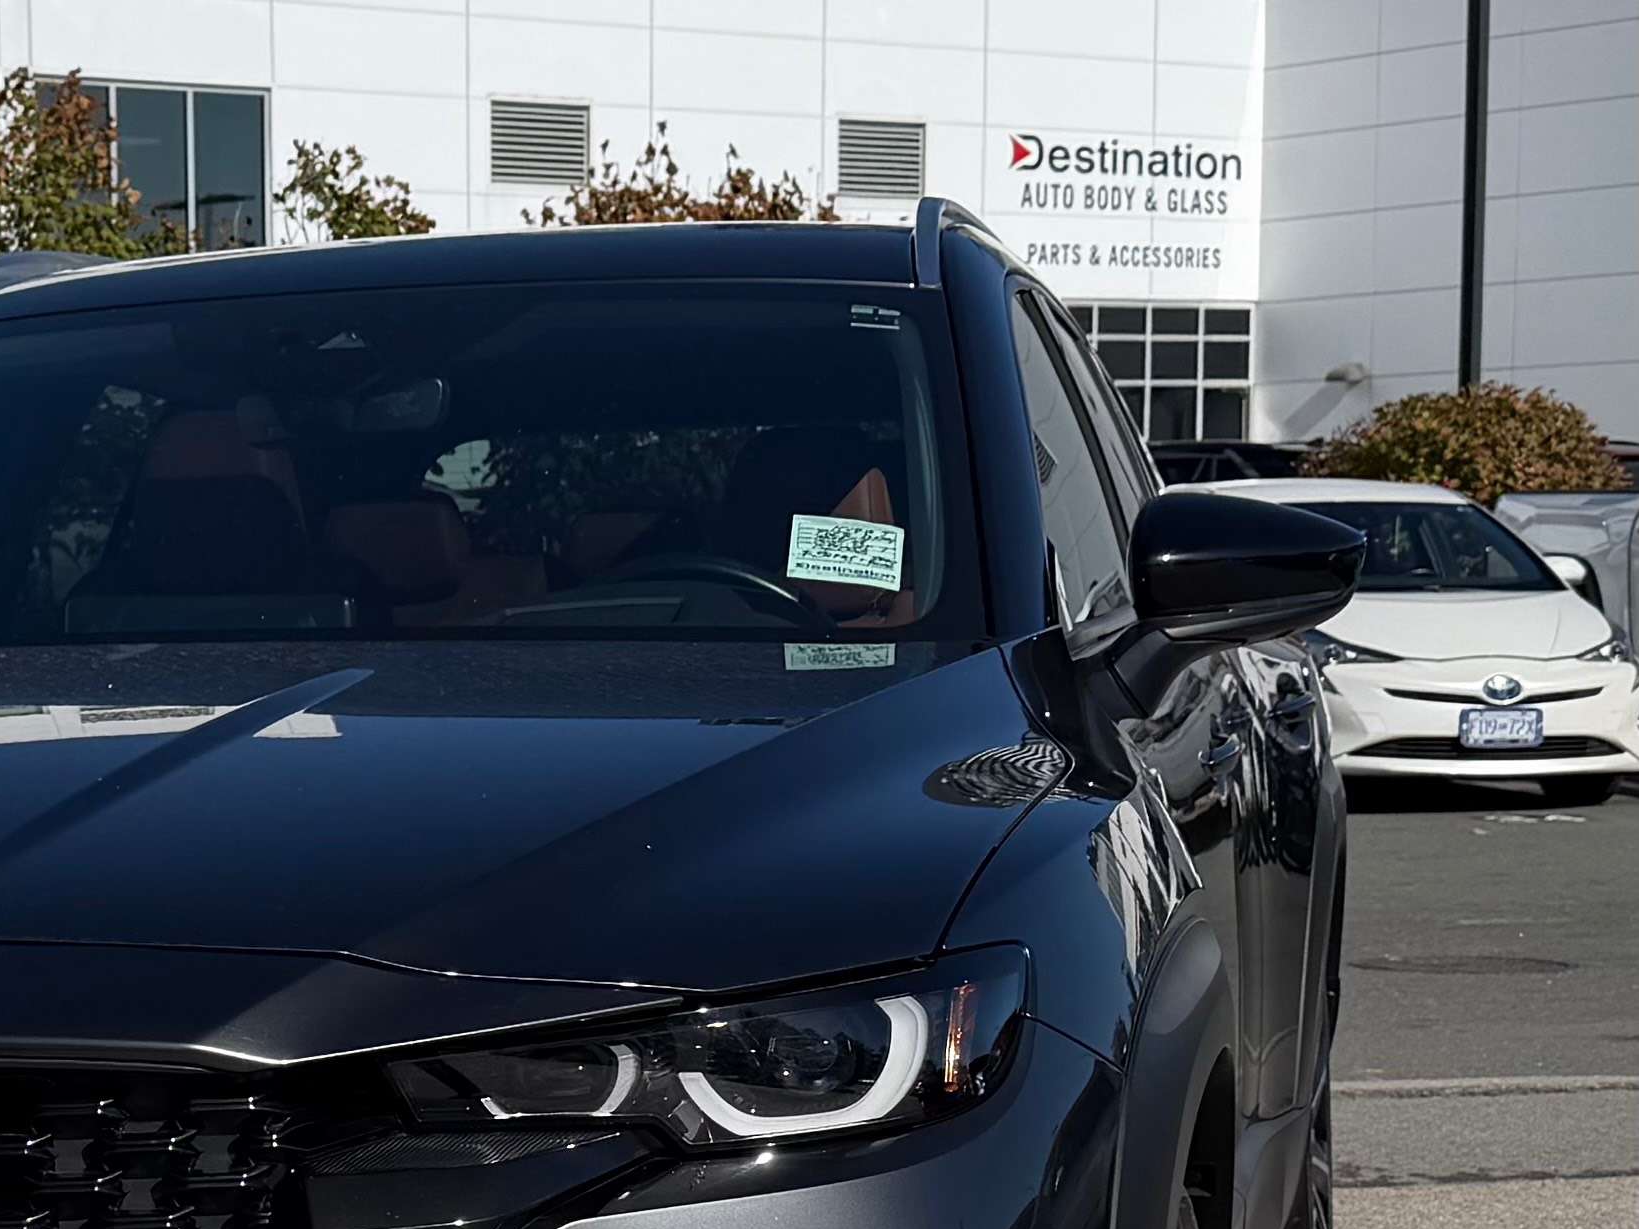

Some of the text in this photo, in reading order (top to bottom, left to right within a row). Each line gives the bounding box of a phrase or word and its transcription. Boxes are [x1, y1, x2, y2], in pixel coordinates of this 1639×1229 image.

[1009, 134, 1242, 181] Destination
[1021, 183, 1228, 215] AUTO BODY & GLASS
[1026, 243, 1222, 269] PARTS & ACCESSORIES
